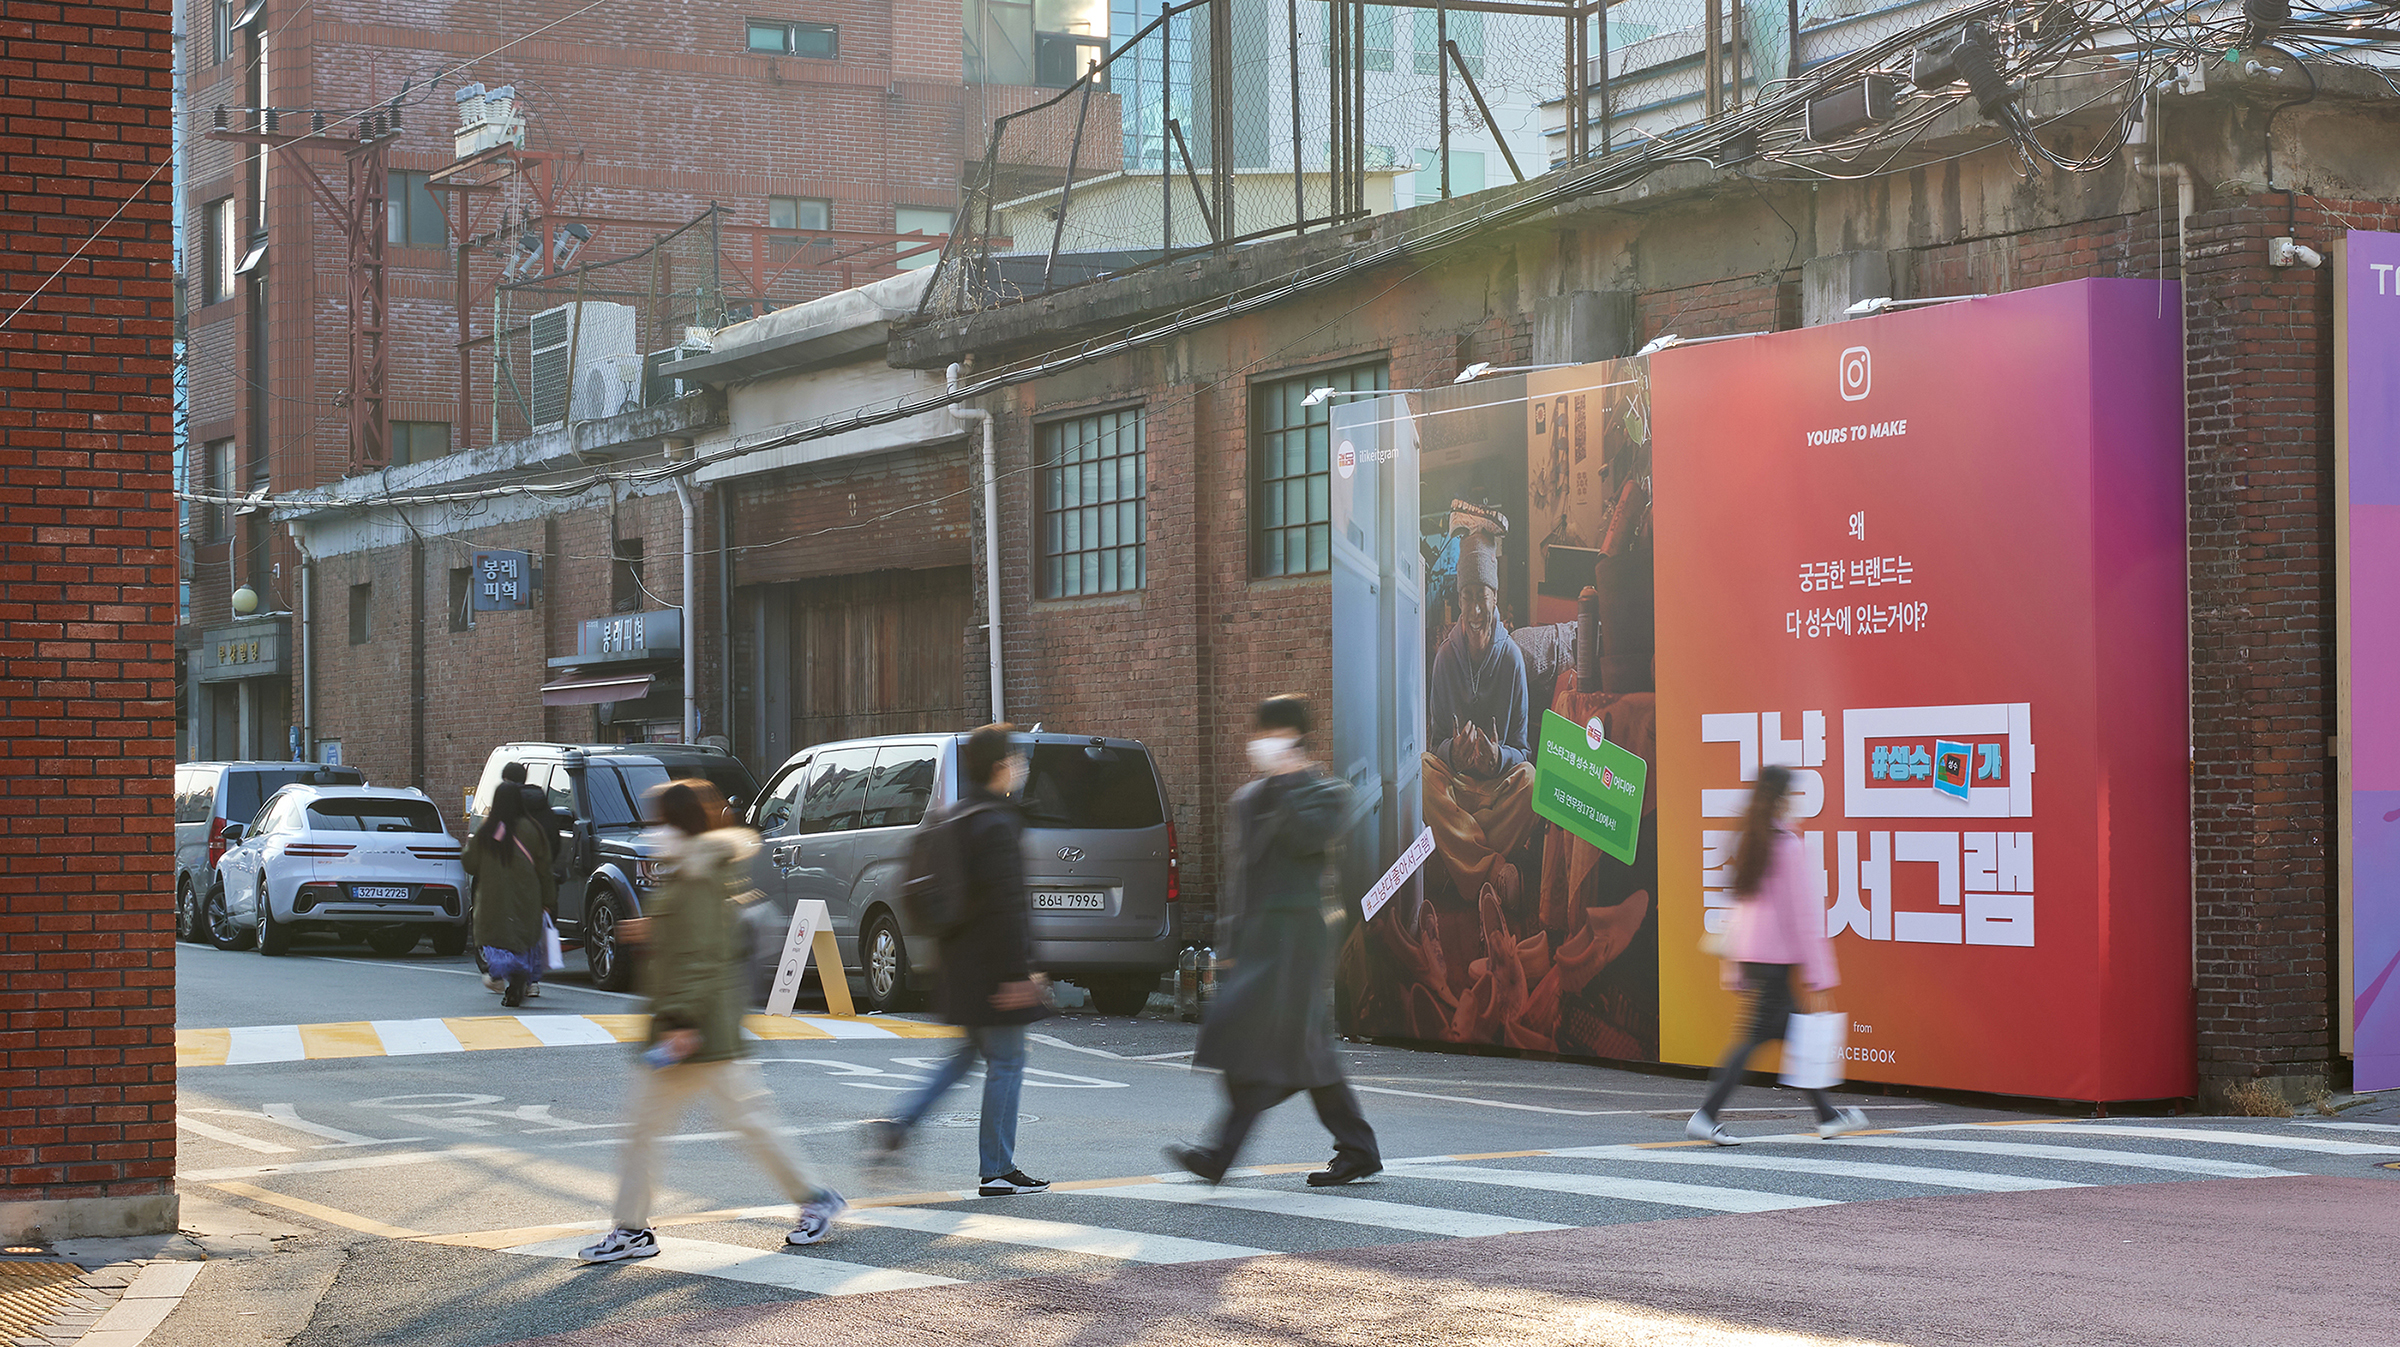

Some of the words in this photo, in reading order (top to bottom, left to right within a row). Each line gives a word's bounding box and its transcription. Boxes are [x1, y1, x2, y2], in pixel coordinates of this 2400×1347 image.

[2370, 263, 2400, 296] T
[1806, 427, 1848, 446] YOURS
[1850, 424, 1867, 441] TO
[1870, 419, 1907, 439] MAKE
[1359, 448, 1399, 463] ilikeitgram
[1848, 510, 1865, 541] 왜
[483, 559, 518, 580] 봉래
[1798, 560, 1845, 592] 궁금한
[1850, 555, 1913, 588] 브랜드는
[483, 581, 518, 602] 피혁
[602, 616, 646, 654] 봉래피혁
[1786, 609, 1801, 639] 다
[1805, 606, 1852, 638] 성수에
[1856, 602, 1928, 635] 있는거야?
[1546, 740, 1576, 765] 인스타그램
[1576, 755, 1590, 772] 성수
[1589, 762, 1602, 780] 전시
[1613, 775, 1636, 797] 어디야?
[1872, 745, 1932, 781] #성수
[1977, 743, 2002, 780] 가
[1553, 787, 1566, 804] 지금
[1366, 833, 1431, 913] #그냥다좋아서그램
[384, 888, 407, 898] 2725
[1038, 894, 1063, 908] 86너
[1067, 894, 1099, 908] 7996
[1853, 1021, 1873, 1033] from
